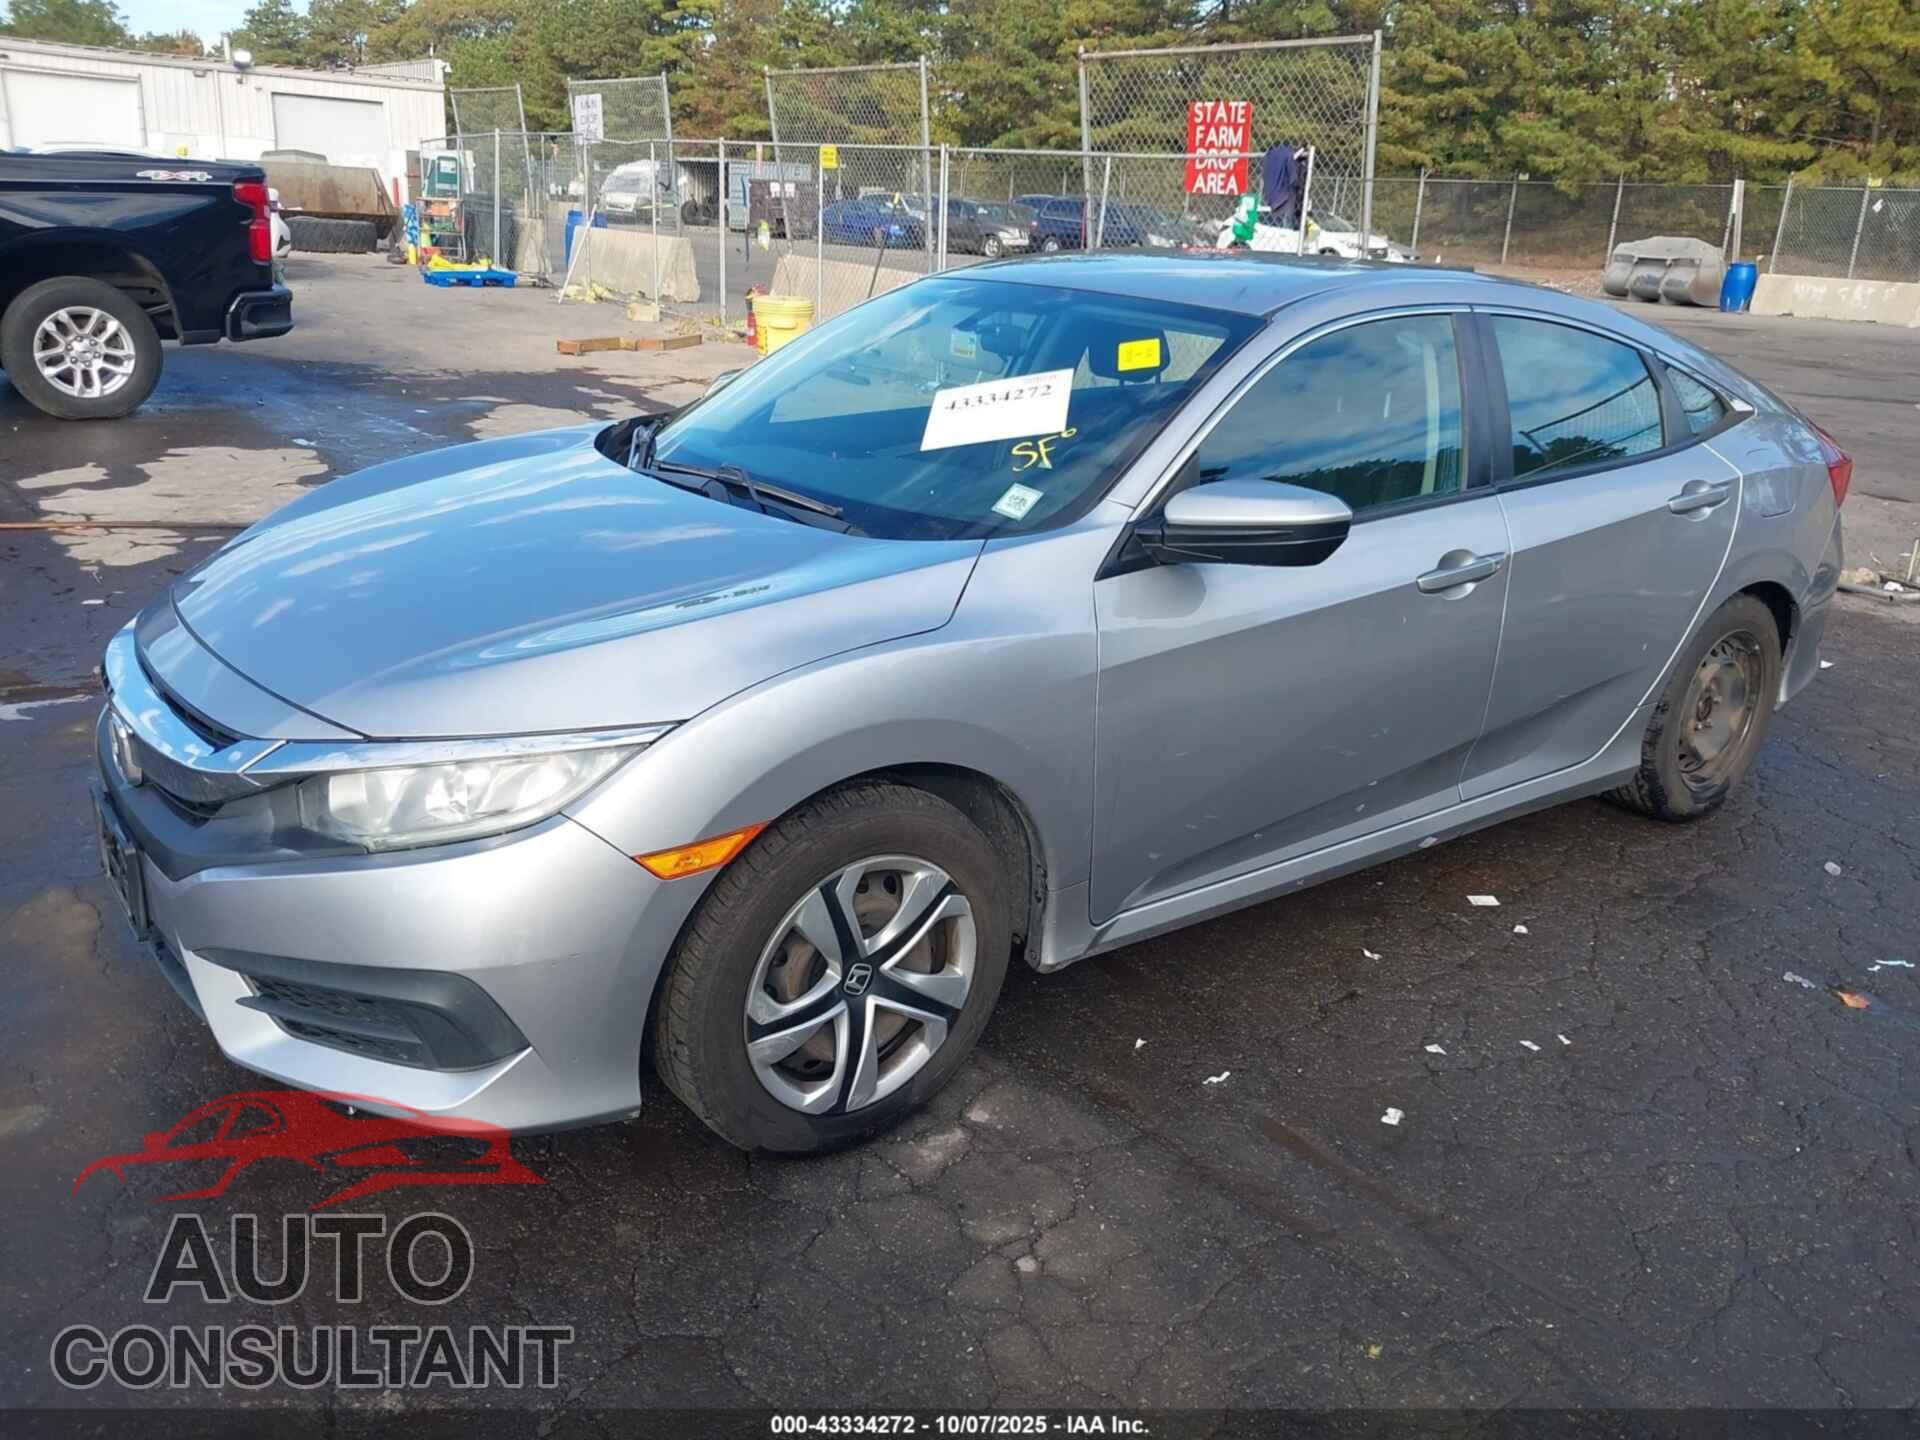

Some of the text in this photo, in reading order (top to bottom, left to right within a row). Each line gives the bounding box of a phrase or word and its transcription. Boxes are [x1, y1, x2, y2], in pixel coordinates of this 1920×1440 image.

[1194, 101, 1248, 123] STATE
[1195, 126, 1244, 147] FARM
[1195, 148, 1239, 170] DROP
[1192, 173, 1239, 195] AREA
